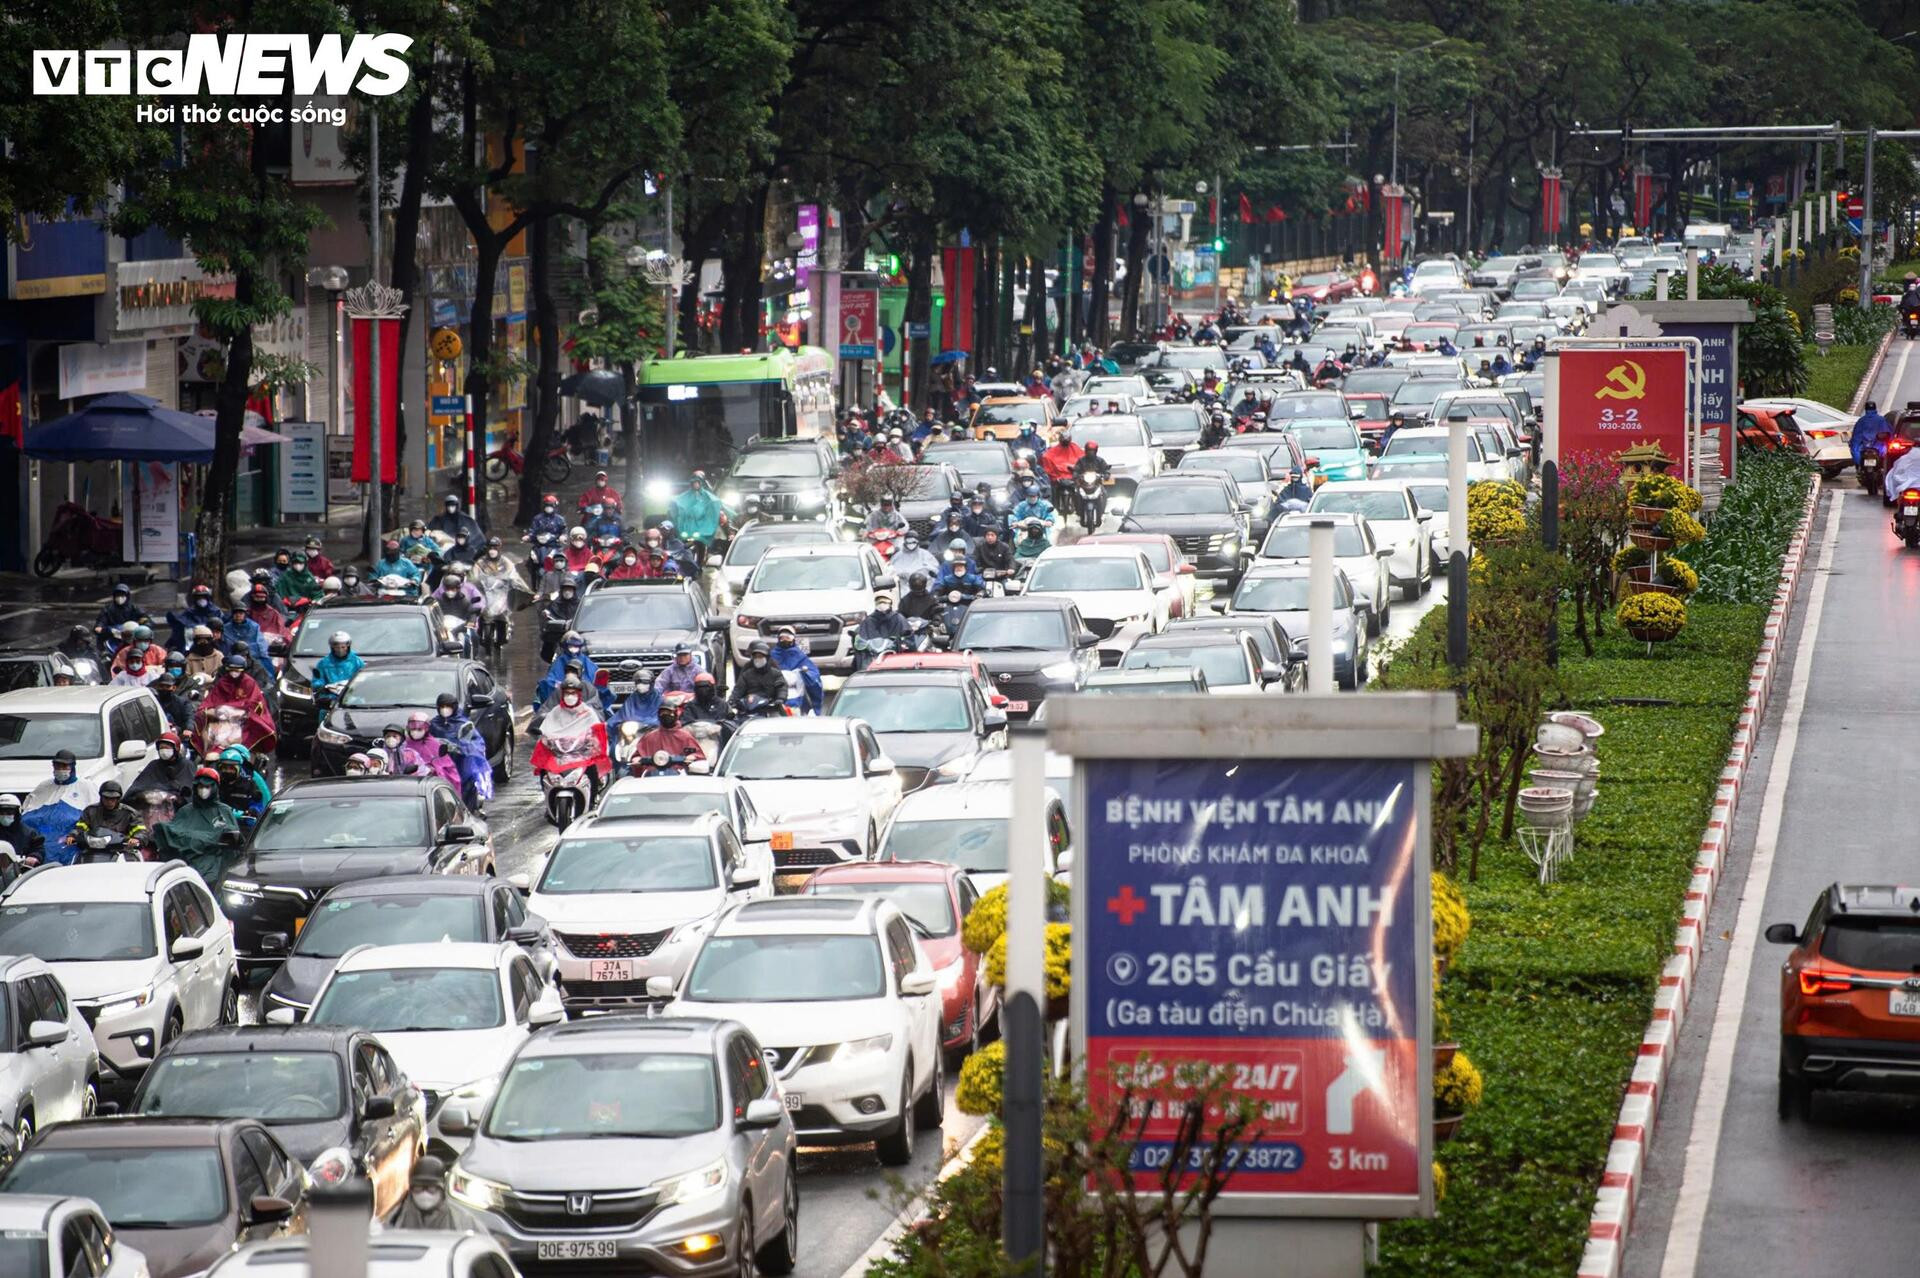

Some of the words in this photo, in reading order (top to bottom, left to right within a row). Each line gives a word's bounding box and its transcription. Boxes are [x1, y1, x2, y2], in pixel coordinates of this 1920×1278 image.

[1601, 408, 1639, 422] 3-2
[1597, 422, 1642, 431] 1930-2026
[1105, 795, 1181, 829] BỆNH
[1190, 795, 1257, 829] VIỆN
[1263, 795, 1324, 823] TÂM
[1331, 799, 1395, 824] ANH
[1128, 842, 1200, 864] PHÒNG
[1207, 842, 1268, 864] KHÁM
[1275, 845, 1303, 864] ĐA
[1310, 845, 1370, 864] KHOA
[1150, 875, 1265, 926] TÂM
[1276, 885, 1394, 926] ANH
[595, 970, 629, 980] 767.15
[603, 961, 621, 970] 37A
[1146, 953, 1218, 986] 265
[1310, 953, 1393, 995] Giấy
[1106, 1000, 1151, 1028] (Ga
[1158, 1000, 1201, 1025] tàu
[1208, 1000, 1267, 1031] điện
[1272, 1001, 1341, 1026] Chùa
[1232, 1063, 1298, 1090] 24/7
[1244, 1147, 1296, 1168] 3872
[1327, 1146, 1345, 1170] 3
[1348, 1147, 1389, 1171] km
[539, 1241, 615, 1258] 30E-975.99
